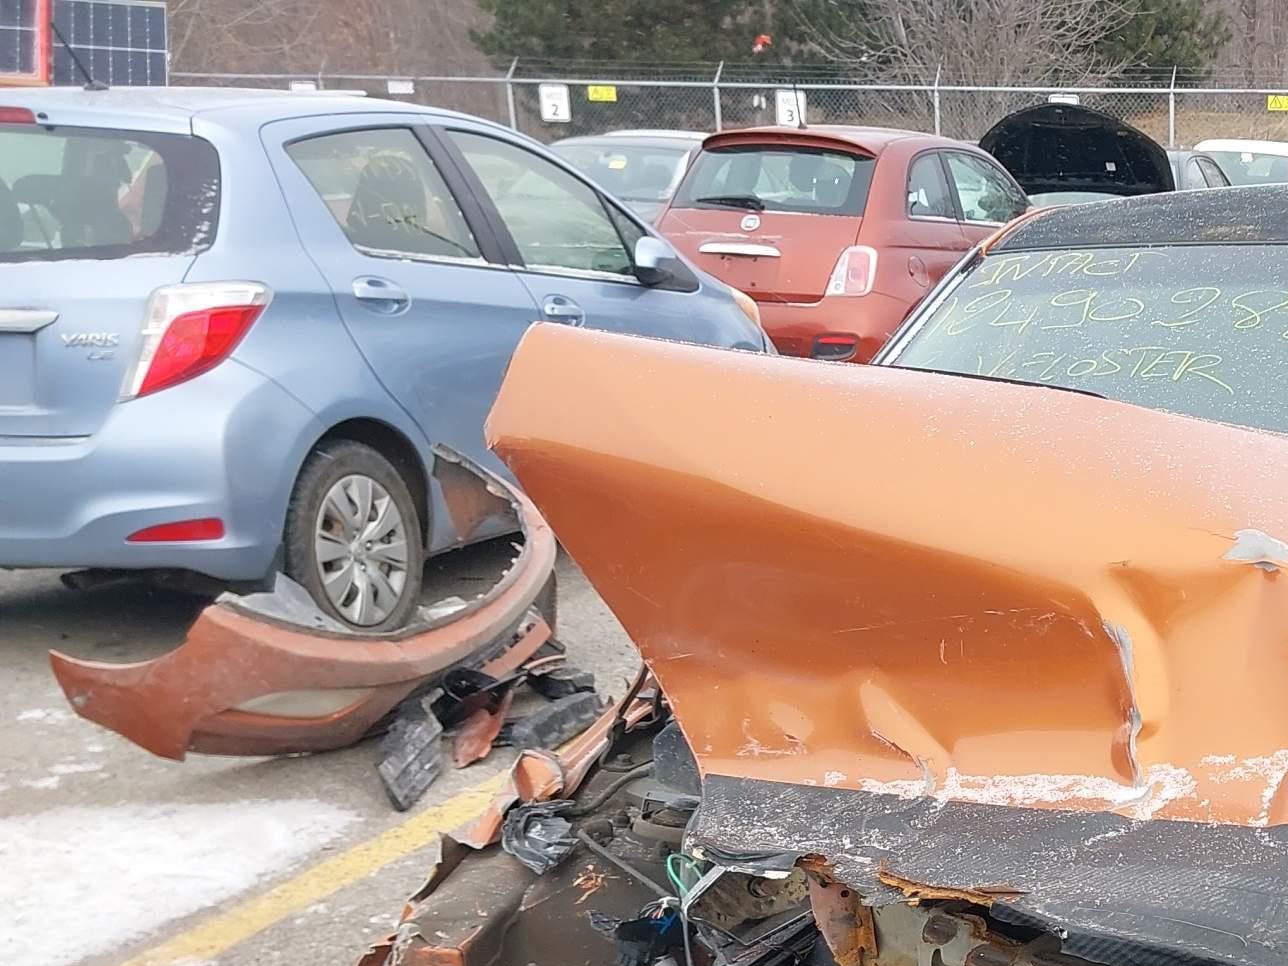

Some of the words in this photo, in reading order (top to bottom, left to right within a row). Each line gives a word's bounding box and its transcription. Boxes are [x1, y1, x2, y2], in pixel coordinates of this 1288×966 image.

[551, 103, 560, 117] 2
[786, 109, 795, 122] 3
[969, 252, 1168, 289] INTACT
